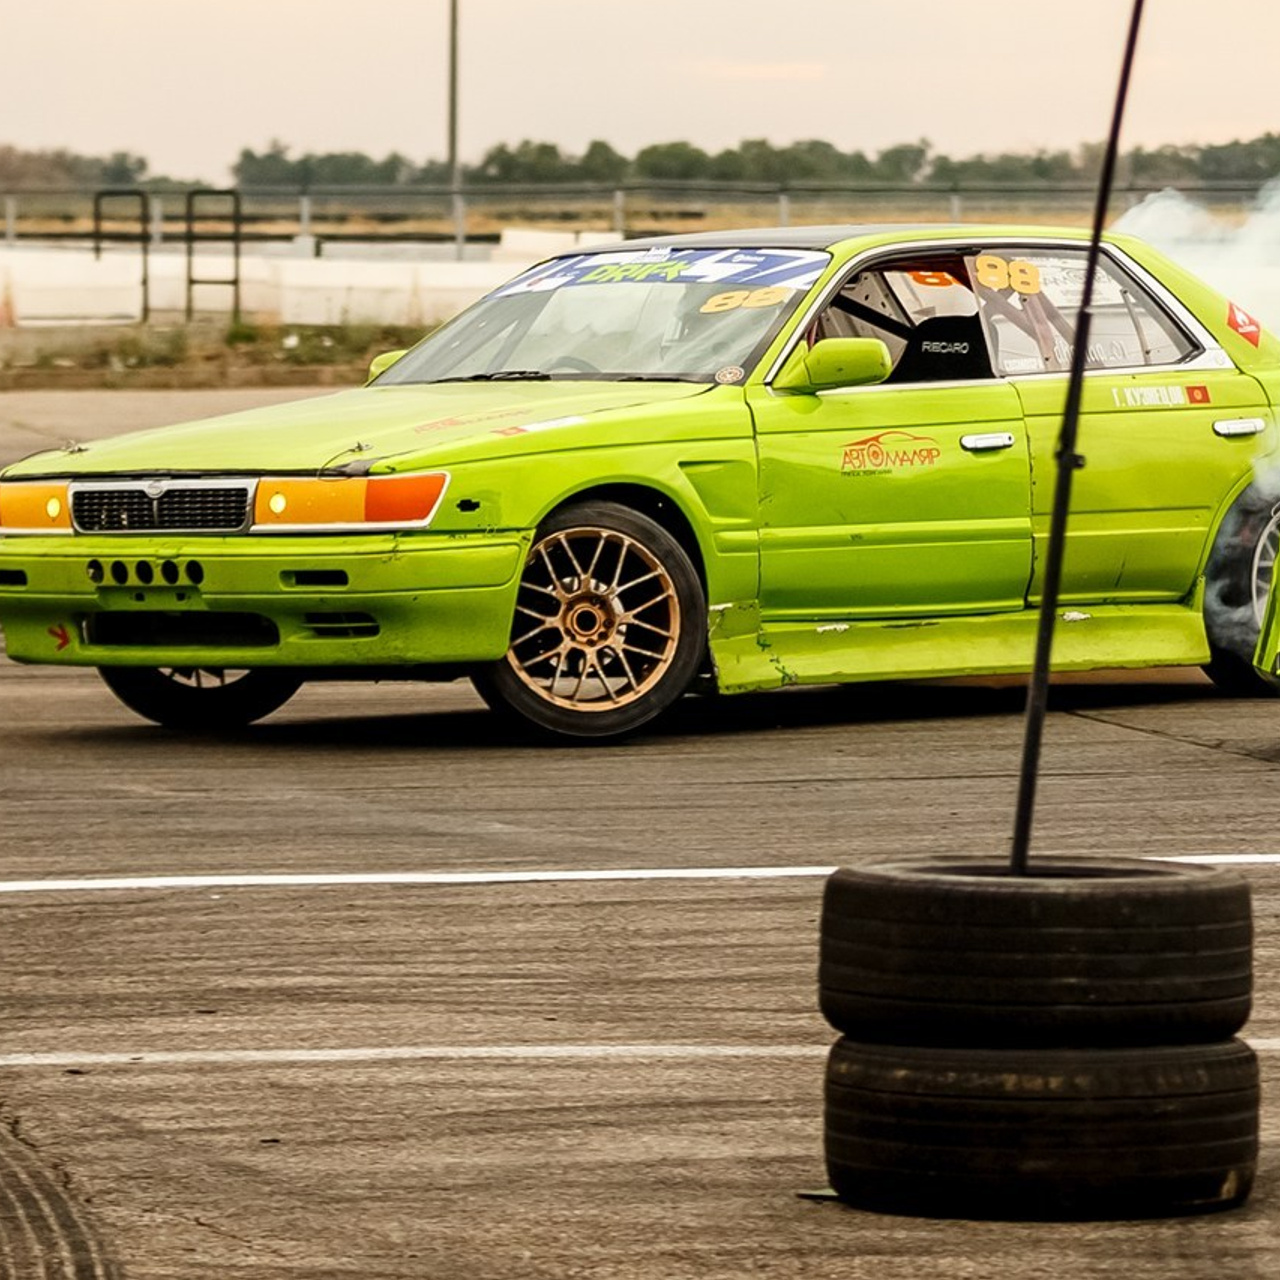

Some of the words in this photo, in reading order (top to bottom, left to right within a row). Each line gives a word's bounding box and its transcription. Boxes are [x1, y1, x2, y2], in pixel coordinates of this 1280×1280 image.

[976, 255, 1040, 294] 88
[701, 286, 788, 313] 88
[921, 341, 969, 354] RECARO
